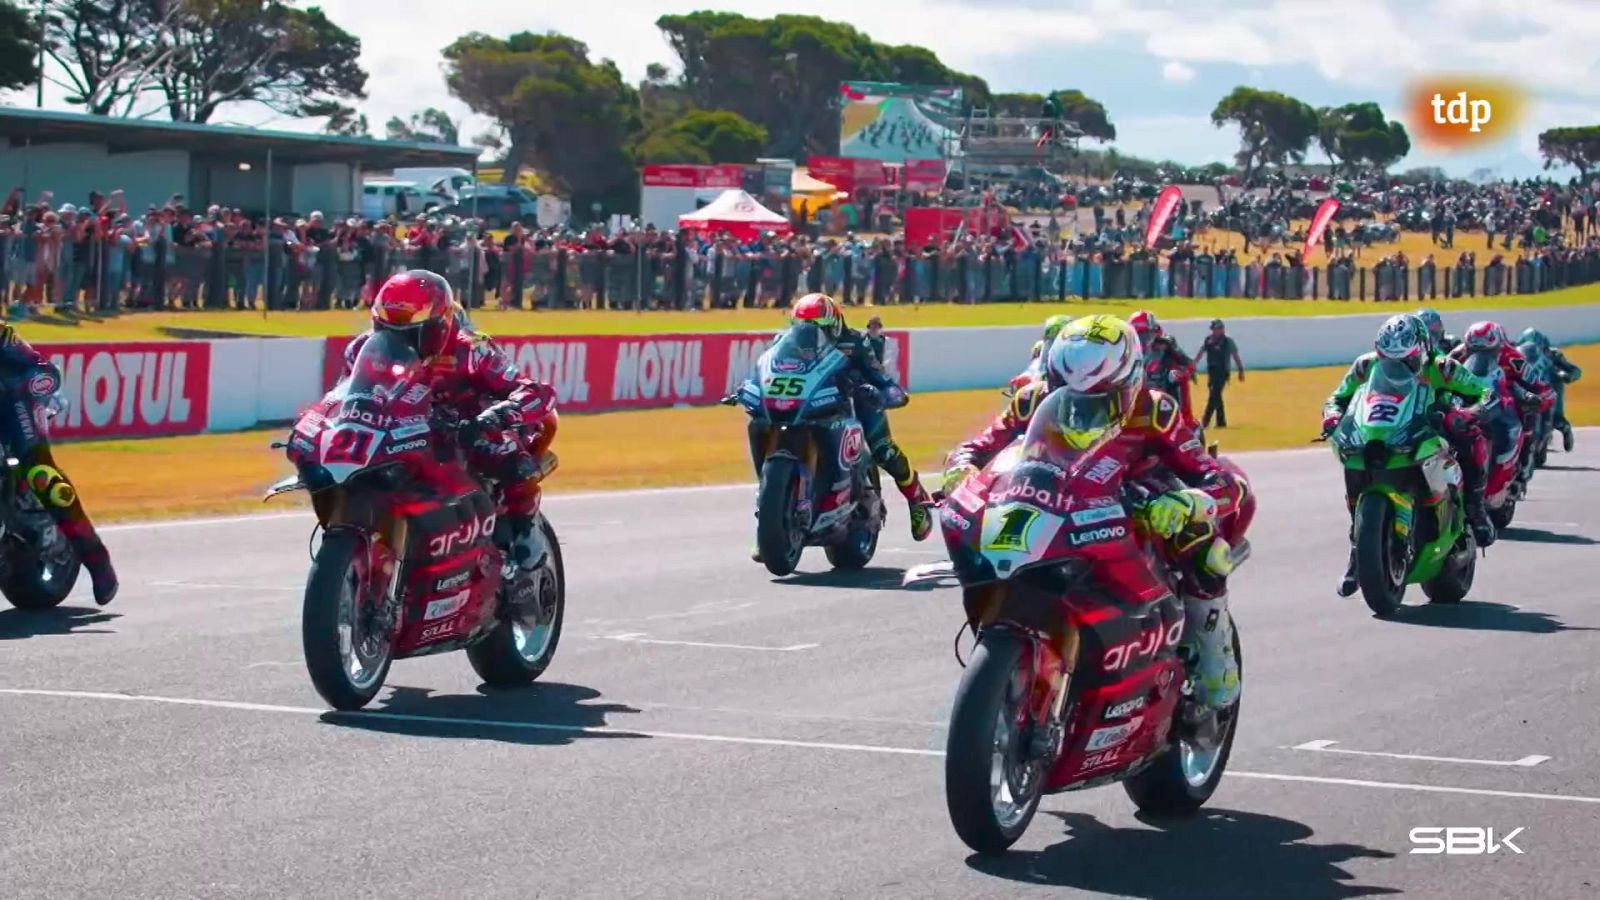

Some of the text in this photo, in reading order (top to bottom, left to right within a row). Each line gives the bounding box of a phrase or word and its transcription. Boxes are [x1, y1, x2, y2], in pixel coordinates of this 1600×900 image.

[613, 340, 704, 401] MOTUL
[51, 351, 192, 430] MOTUL
[768, 377, 806, 397] 55
[1368, 403, 1400, 423] 22
[323, 427, 375, 464] 21
[386, 438, 428, 455] Lenovo
[984, 506, 1041, 553] 1
[1070, 525, 1126, 545] Lenovo
